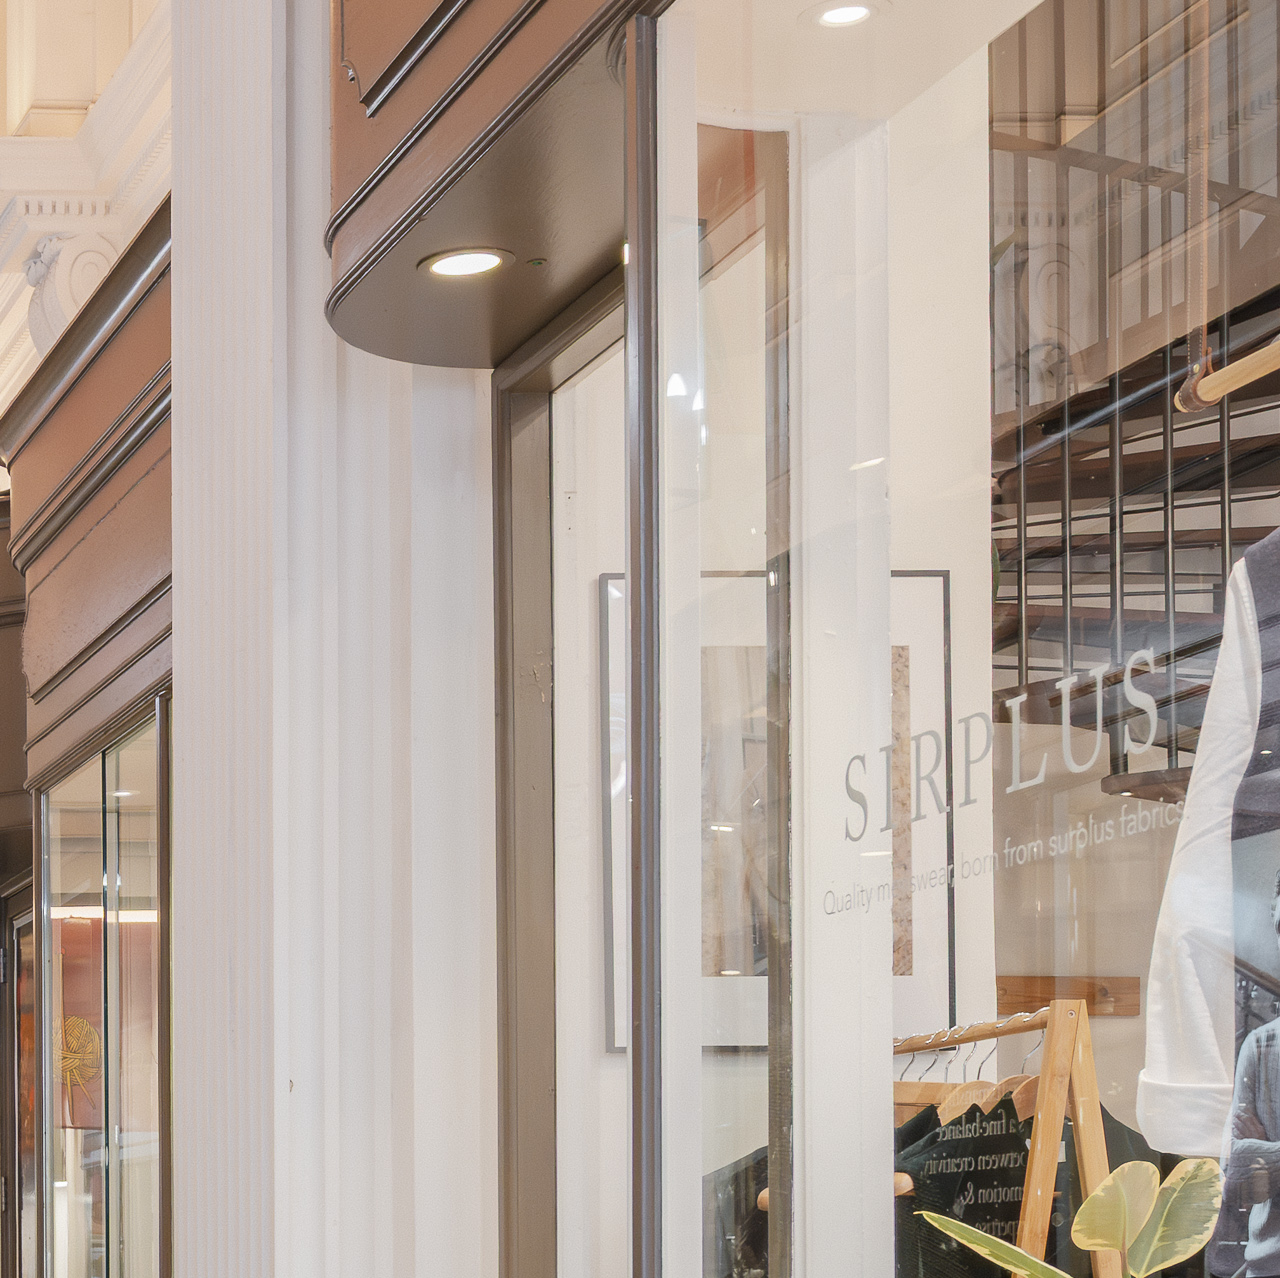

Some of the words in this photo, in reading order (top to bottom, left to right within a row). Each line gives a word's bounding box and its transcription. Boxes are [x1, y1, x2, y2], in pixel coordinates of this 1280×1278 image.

[844, 647, 1158, 842] SIRPLUS
[823, 882, 875, 916] Quality
[961, 851, 998, 880] born
[1003, 837, 1044, 869] from
[1049, 811, 1115, 859] surplus
[1120, 797, 1184, 838] fabrics
